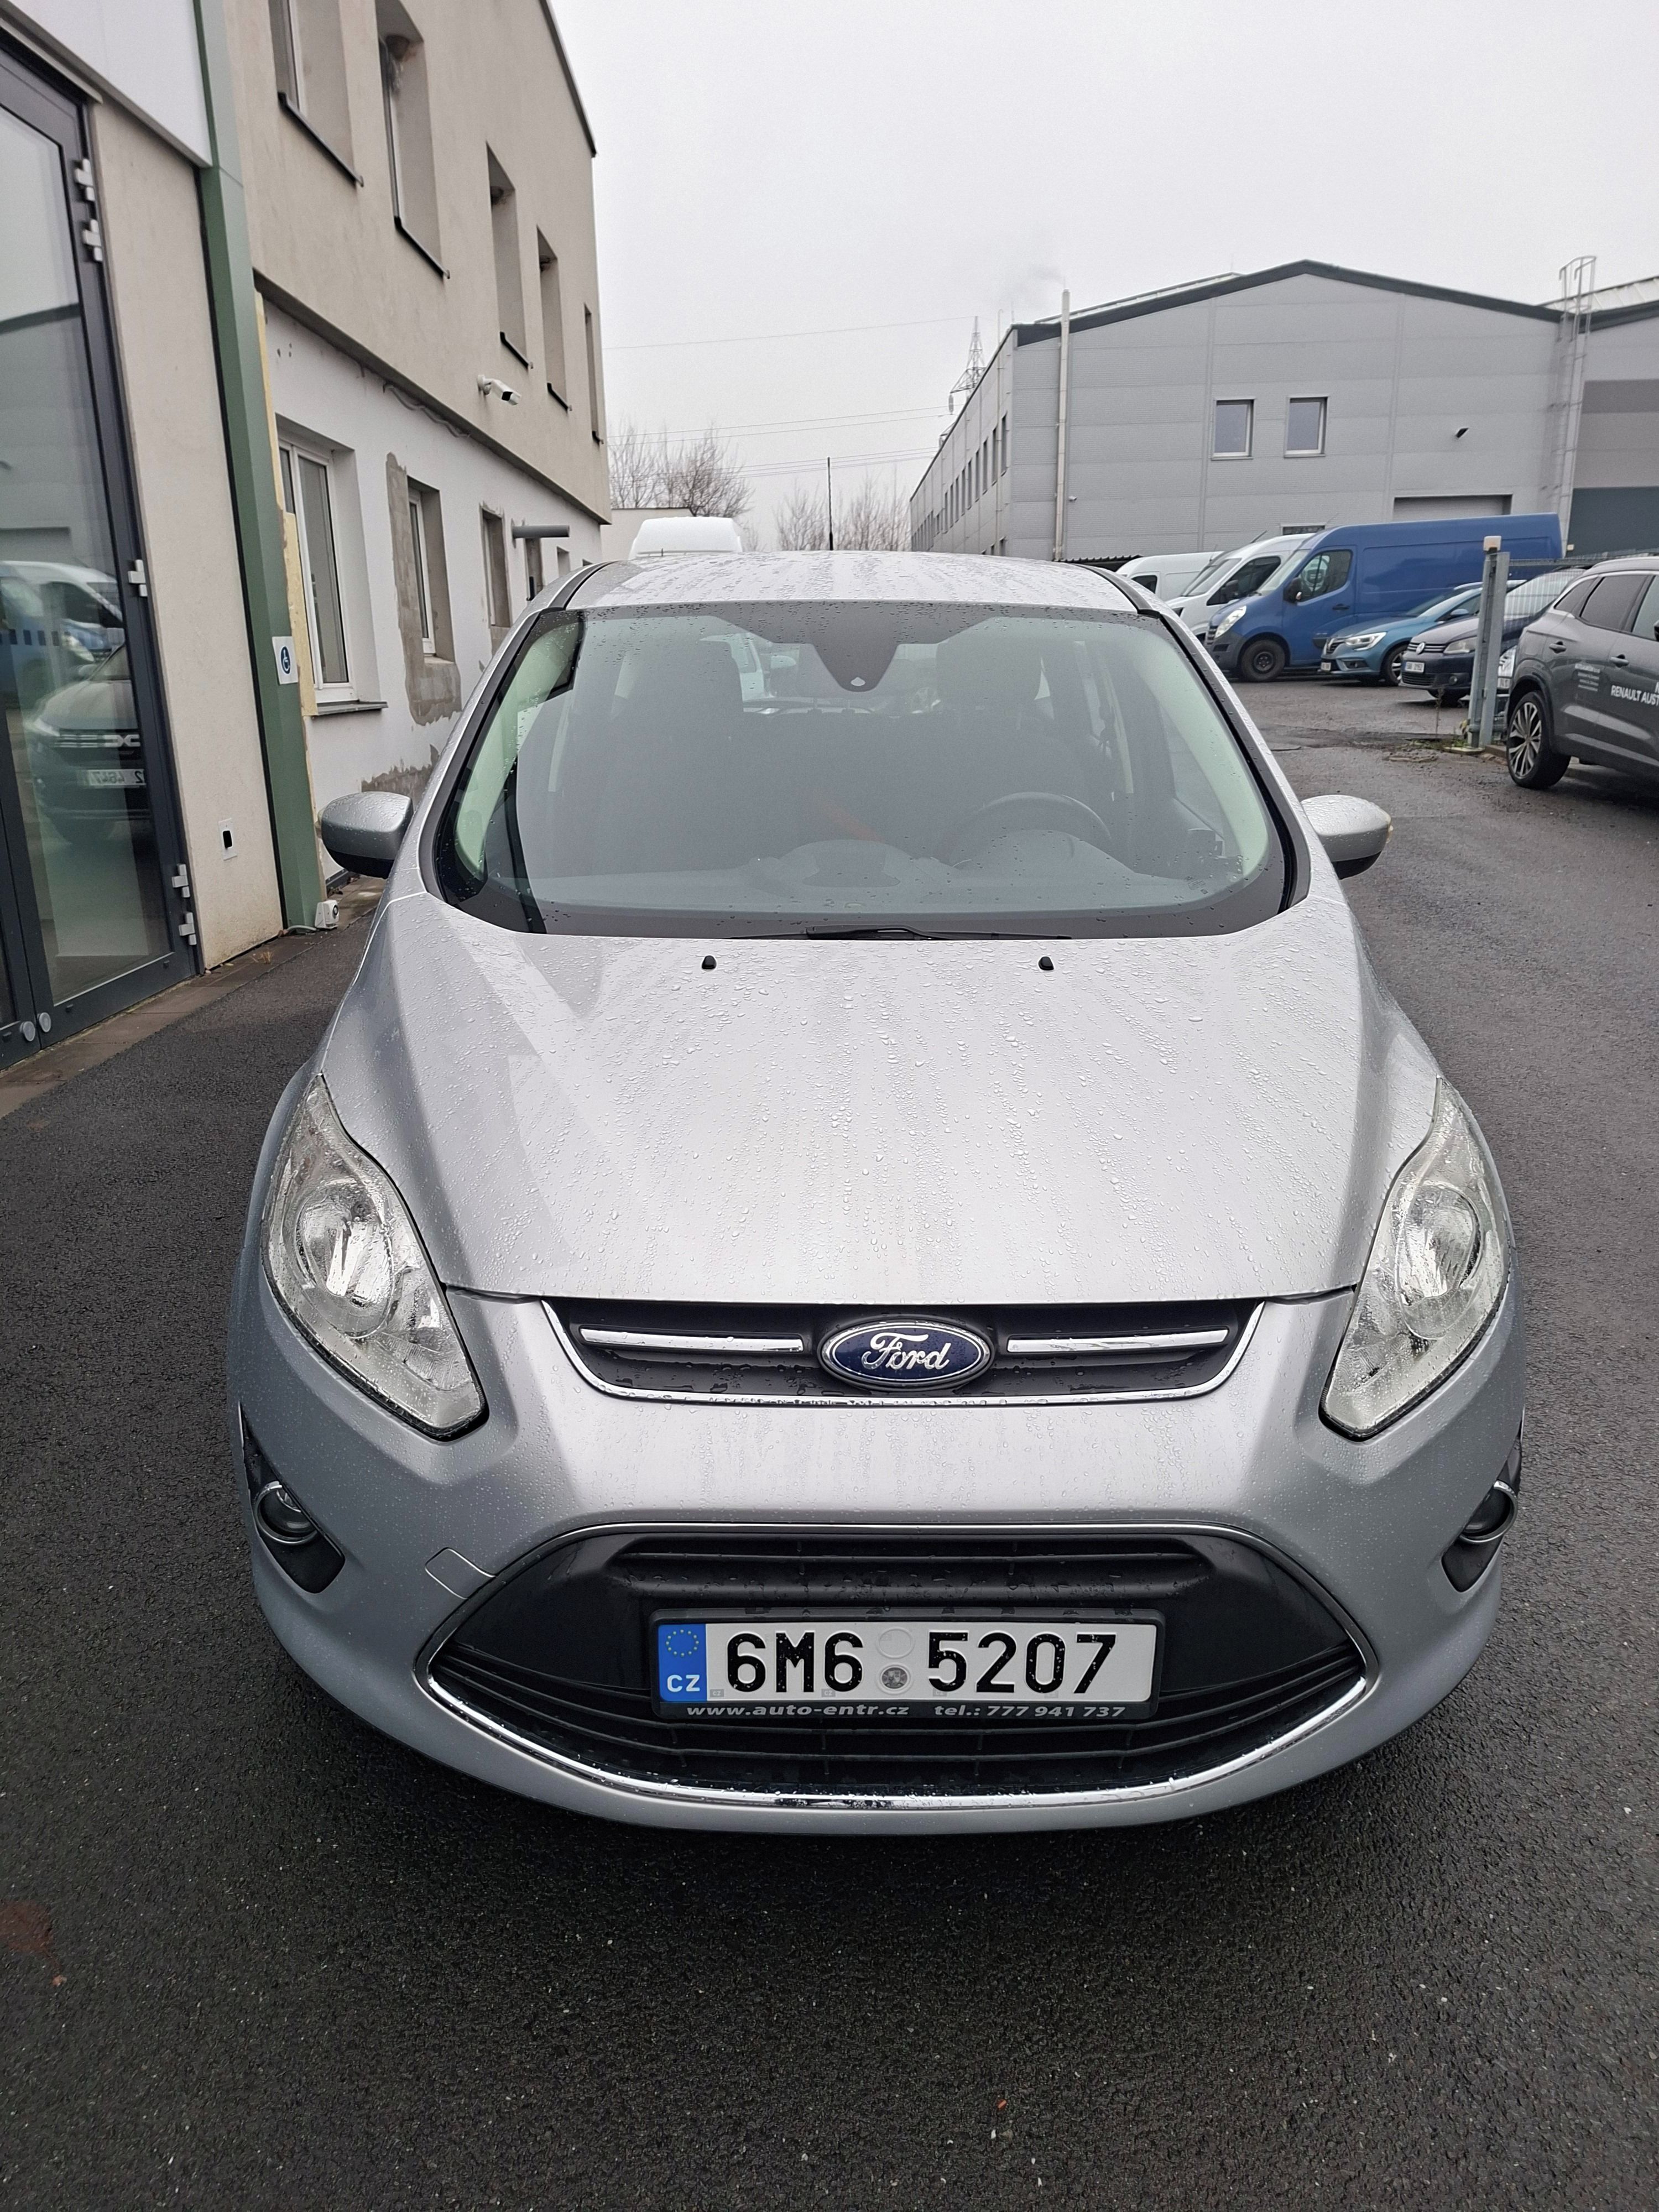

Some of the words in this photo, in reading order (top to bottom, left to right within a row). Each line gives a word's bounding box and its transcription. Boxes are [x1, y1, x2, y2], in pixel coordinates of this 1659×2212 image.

[1610, 685, 1642, 702] RENAULT
[862, 1332, 952, 1370] Ford
[727, 1632, 863, 1692] 6M6
[928, 1632, 1117, 1694] 5207
[667, 1674, 700, 1692] CZ
[687, 1704, 909, 1715] www.auto-entr.cz
[935, 1705, 981, 1715] tel.:
[987, 1705, 1030, 1717] 777
[1035, 1707, 1074, 1717] 941
[1083, 1707, 1125, 1717] 737
